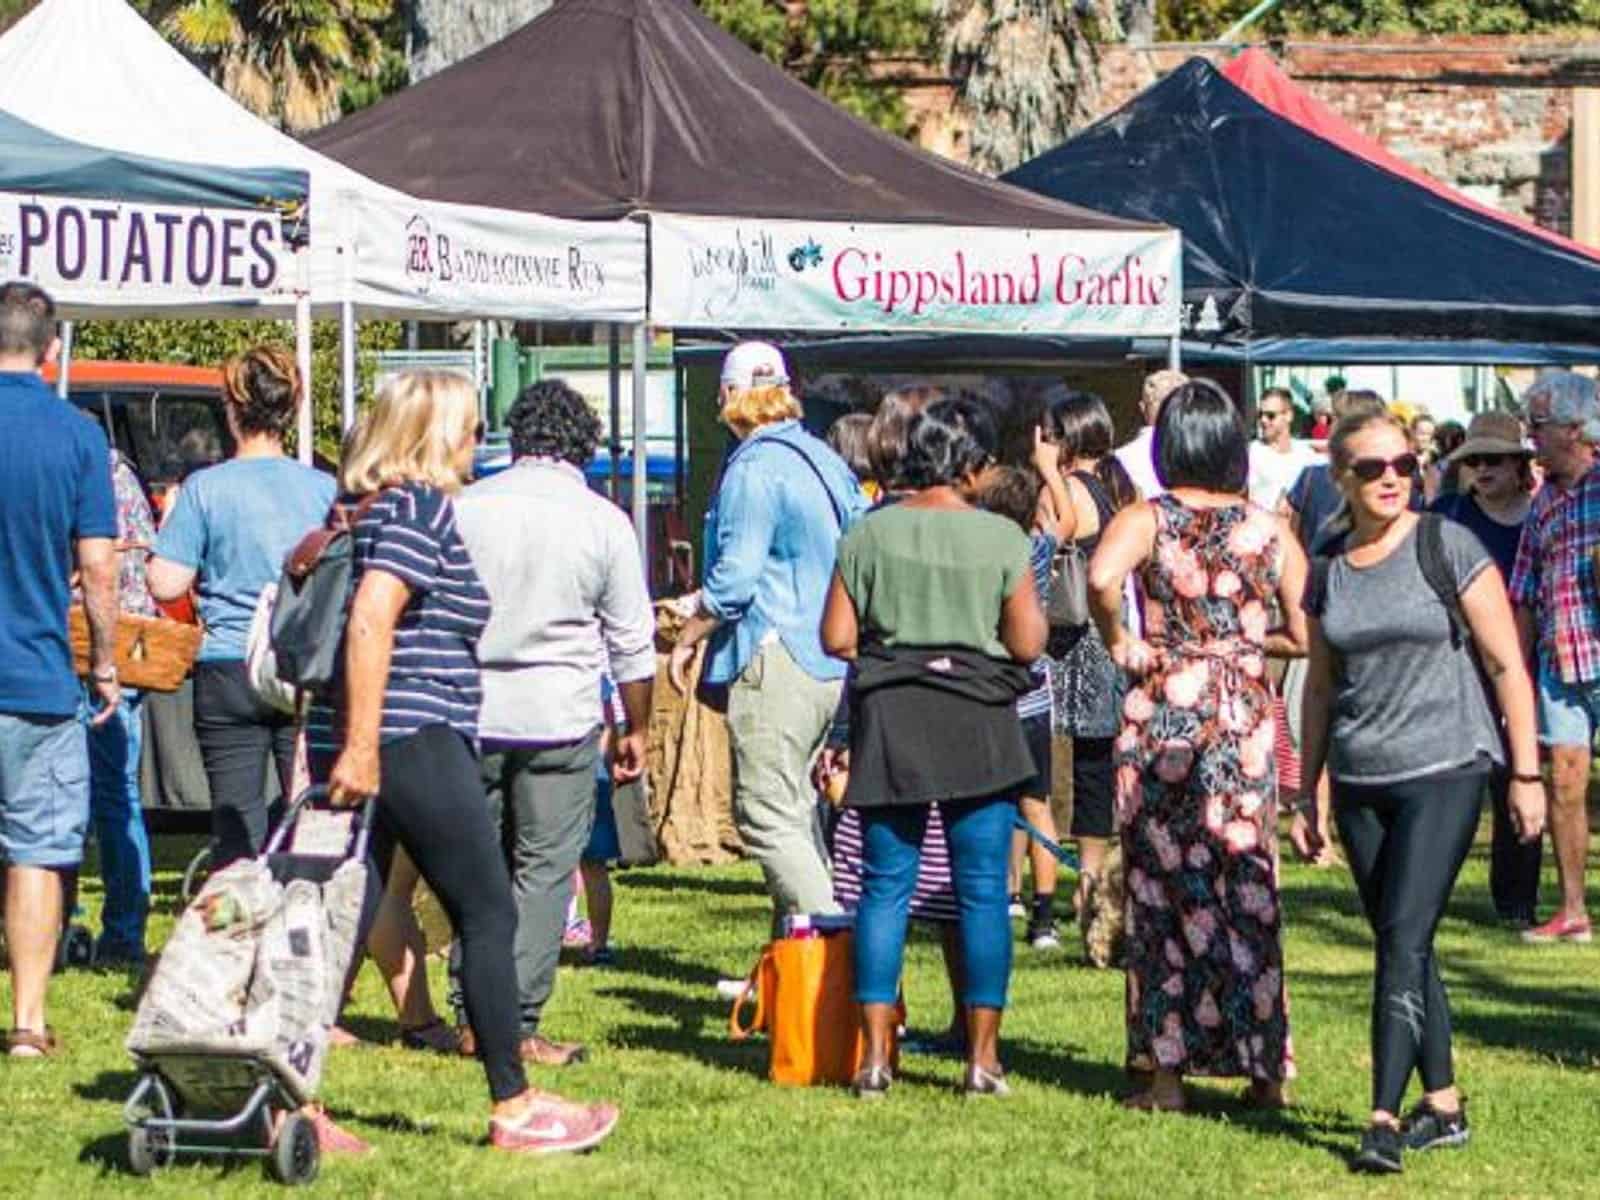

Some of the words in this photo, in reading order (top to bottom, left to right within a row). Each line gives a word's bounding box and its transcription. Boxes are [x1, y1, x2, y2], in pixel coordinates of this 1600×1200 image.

[19, 204, 278, 289] POTATOES
[831, 246, 1041, 314] Gippsland
[1055, 251, 1169, 305] Garlic
